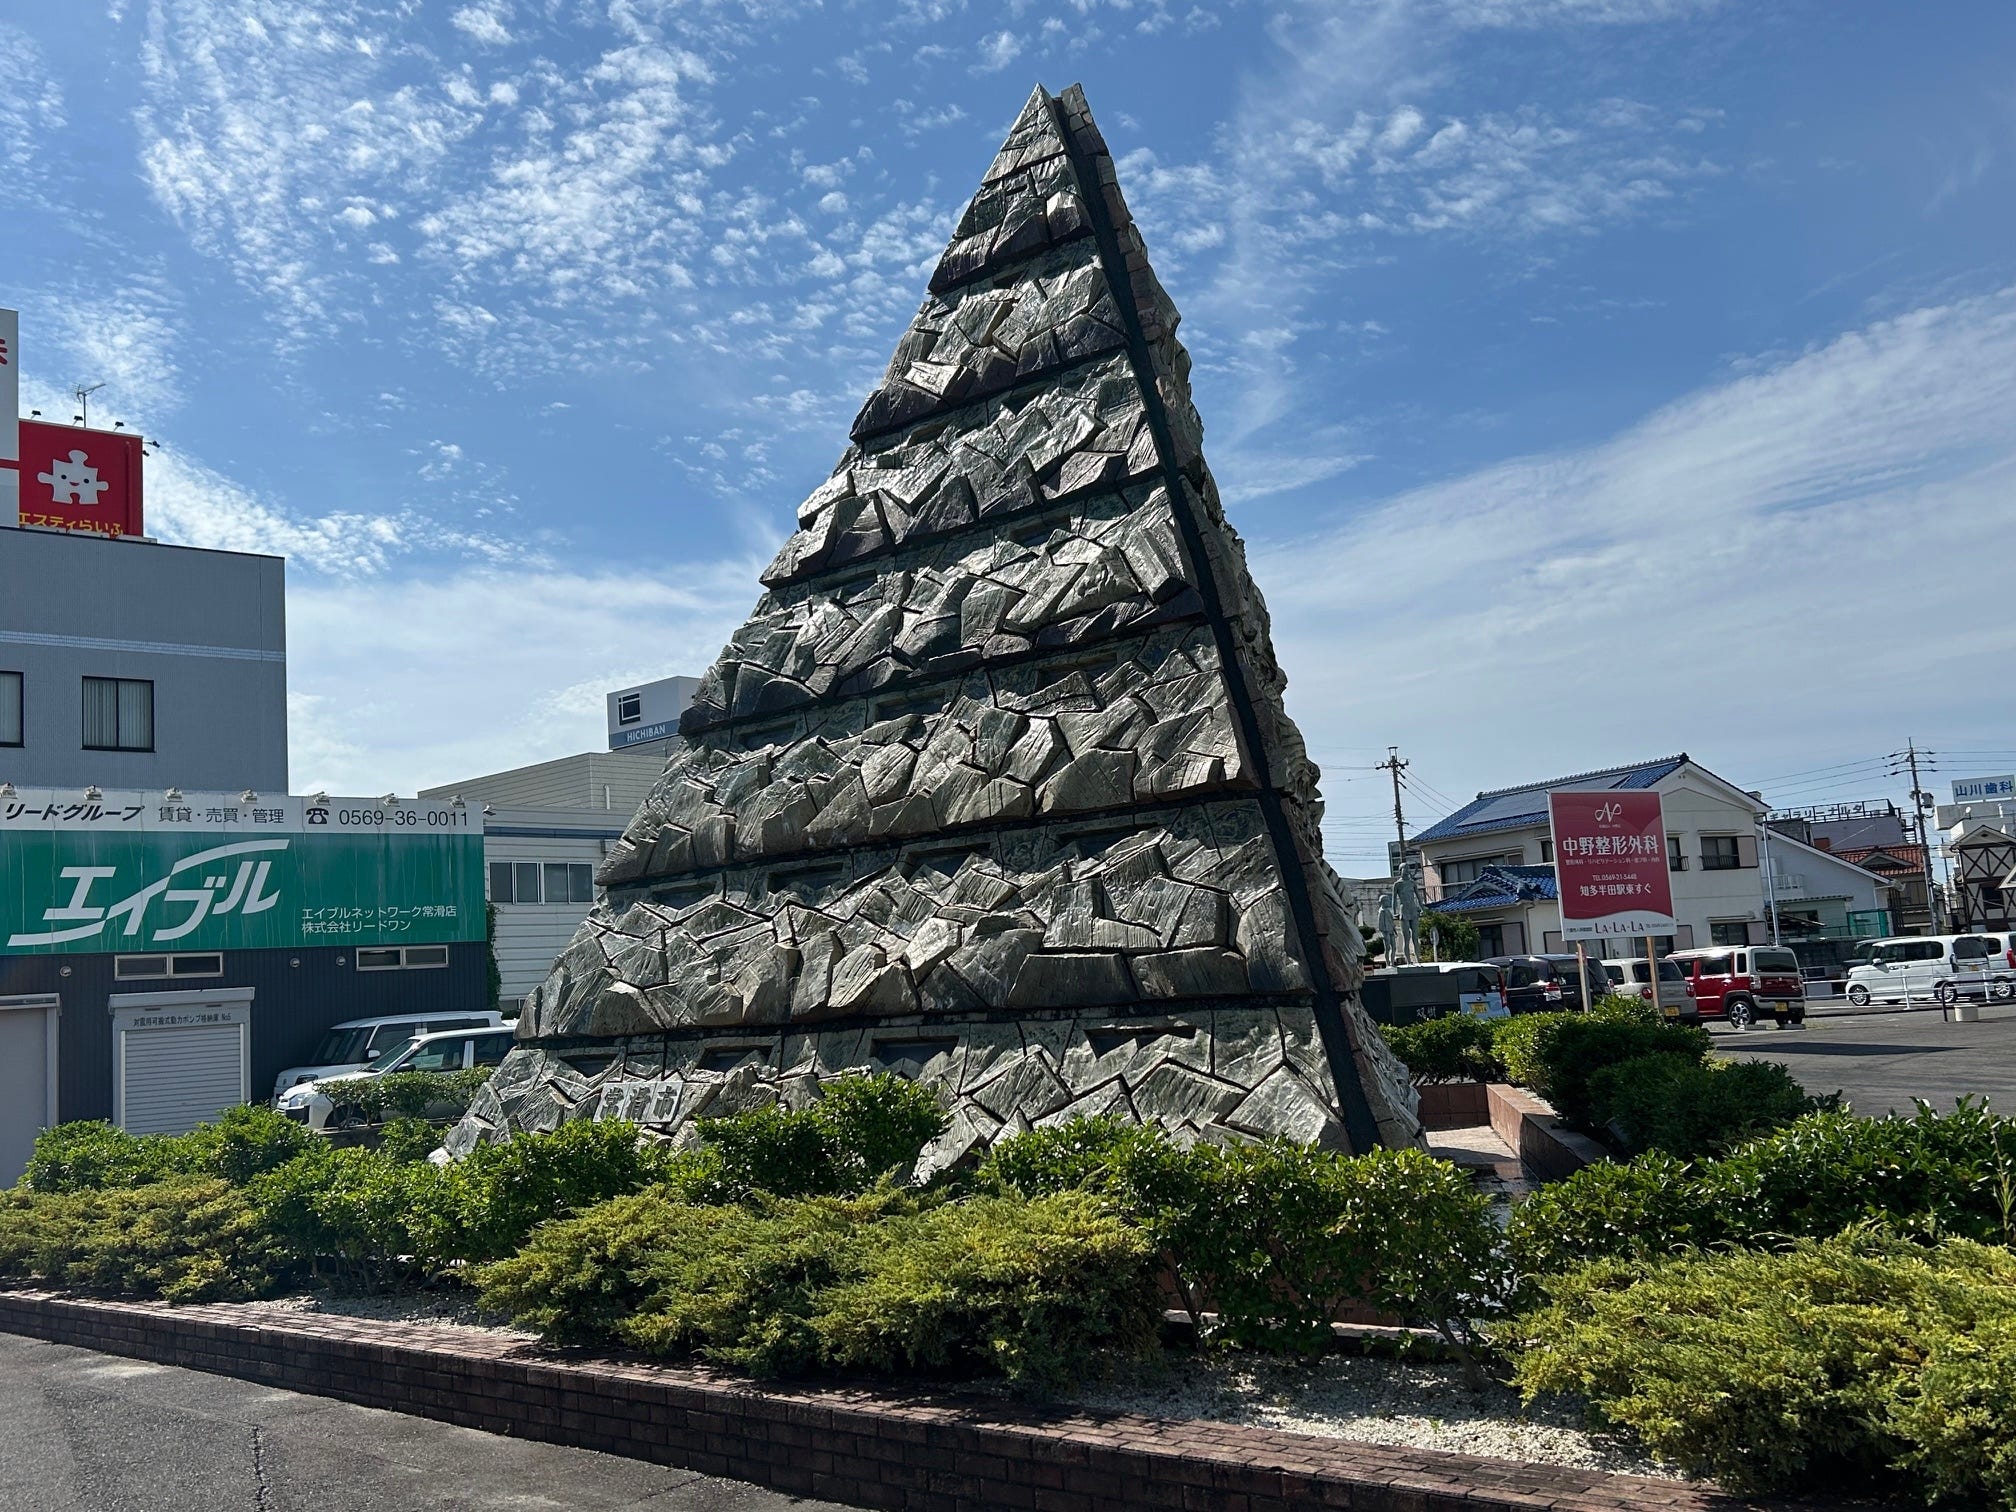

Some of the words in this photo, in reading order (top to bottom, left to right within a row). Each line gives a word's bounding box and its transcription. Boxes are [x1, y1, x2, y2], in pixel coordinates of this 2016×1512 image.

[19, 512, 123, 535] エスティらいふ
[627, 725, 666, 742] HICHIBAN
[1955, 780, 2013, 797] 山川歯科
[6, 803, 145, 821] リードグループ
[158, 807, 284, 824] 賃貸・売買・管理
[339, 809, 468, 826] 0569-36-0011
[1562, 834, 1659, 857] 中野整形外科
[7, 839, 290, 946] エイブル
[1580, 883, 1652, 897] 知多半田駅東すぐ
[302, 906, 457, 920] エイブルネットワーク常滑店
[301, 919, 412, 933] 株式会社リードワン
